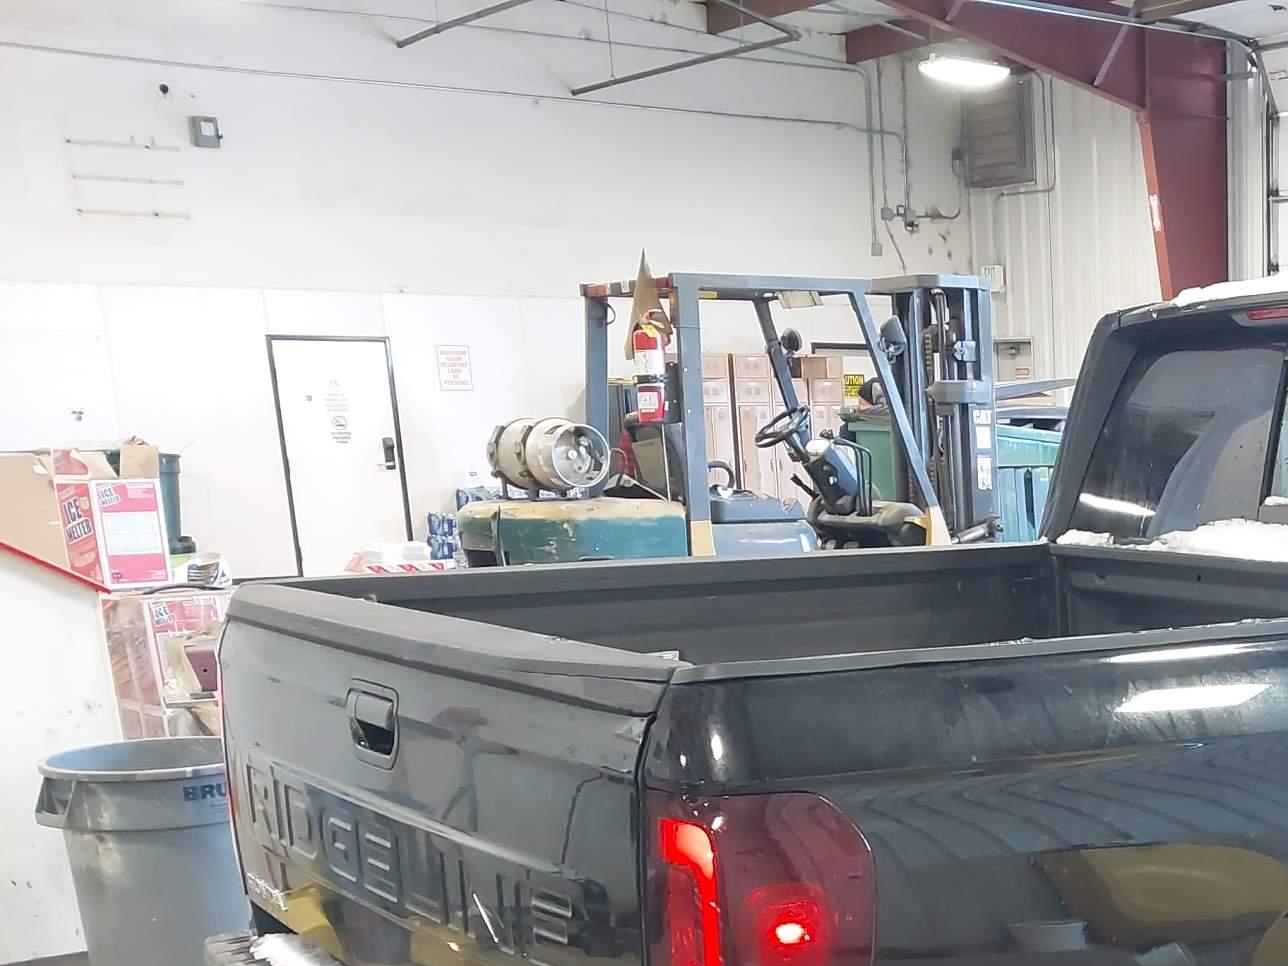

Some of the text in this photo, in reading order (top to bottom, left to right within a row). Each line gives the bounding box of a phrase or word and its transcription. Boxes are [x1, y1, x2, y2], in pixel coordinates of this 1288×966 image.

[845, 375, 864, 385] UTION
[101, 487, 113, 500] ICE
[63, 498, 82, 524] ICE
[65, 519, 92, 543] MELTER
[183, 783, 226, 801] BRU
